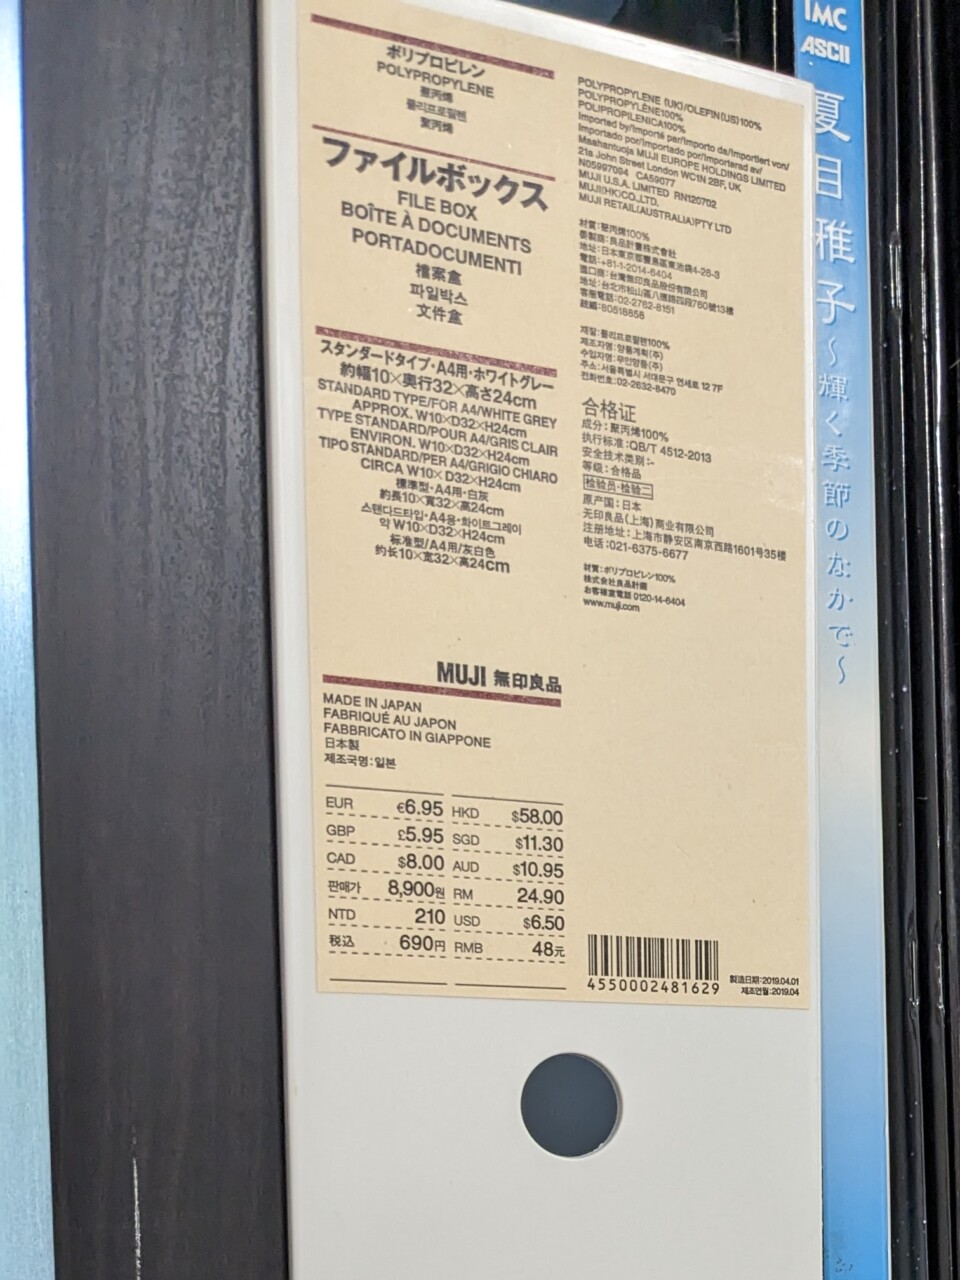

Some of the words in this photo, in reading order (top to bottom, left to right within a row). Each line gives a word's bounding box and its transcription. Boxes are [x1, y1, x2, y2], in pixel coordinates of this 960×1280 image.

[800, 36, 850, 65] ASCII
[377, 61, 495, 98] POLYPROPYLENE
[323, 137, 548, 212] ファイルボックス
[397, 190, 436, 213] FILE
[440, 199, 478, 221] BOX
[341, 200, 397, 226] BOÎTE
[401, 210, 414, 230] À
[418, 219, 532, 254] DOCUMENTS
[352, 227, 522, 276] PORTADOCUMENTI
[410, 283, 468, 306] 파일박스
[416, 303, 463, 325] 文件盒
[318, 379, 391, 401] STANDARD
[523, 415, 557, 429] GREY
[582, 397, 637, 423] 合格证
[317, 407, 353, 423] TYPE
[521, 443, 558, 457] CLAIR
[319, 436, 349, 451] TIPO
[513, 468, 558, 485] CHIARO
[361, 458, 403, 474] CIRCA
[437, 661, 486, 687] MUJI
[493, 669, 562, 693] 無印良品
[323, 693, 361, 707] MADE
[365, 697, 377, 708] IN
[381, 699, 422, 713] JAPAN
[323, 707, 390, 724] FABRIQUÉ
[393, 714, 410, 726] AU
[414, 717, 457, 730] JAPON
[323, 723, 406, 740] FABBRICATO
[409, 730, 421, 741] IN
[425, 732, 491, 748] GIAPPONE
[325, 796, 353, 810] EUR
[397, 798, 444, 816] €6.95
[452, 806, 480, 819] HKD
[511, 808, 563, 826] $58.00
[326, 824, 355, 837] GBP
[398, 826, 444, 844] £5.95
[452, 834, 480, 846] SGD
[515, 834, 564, 852] $11.30
[326, 852, 355, 865] CAD
[398, 854, 445, 871] $8.00
[452, 861, 480, 873] AUD
[513, 861, 564, 879] $10.95
[328, 880, 361, 894] 판매가
[453, 889, 473, 900] RM
[517, 888, 564, 905] 24.90
[329, 908, 356, 920] NTD
[415, 908, 446, 925] 210
[454, 915, 481, 927] USD
[523, 915, 565, 931] $6.50
[329, 934, 355, 948] 税込
[399, 934, 446, 952] 690円
[454, 942, 483, 954] RMB
[532, 941, 565, 958] 48元
[587, 978, 720, 995] 4550002481629
